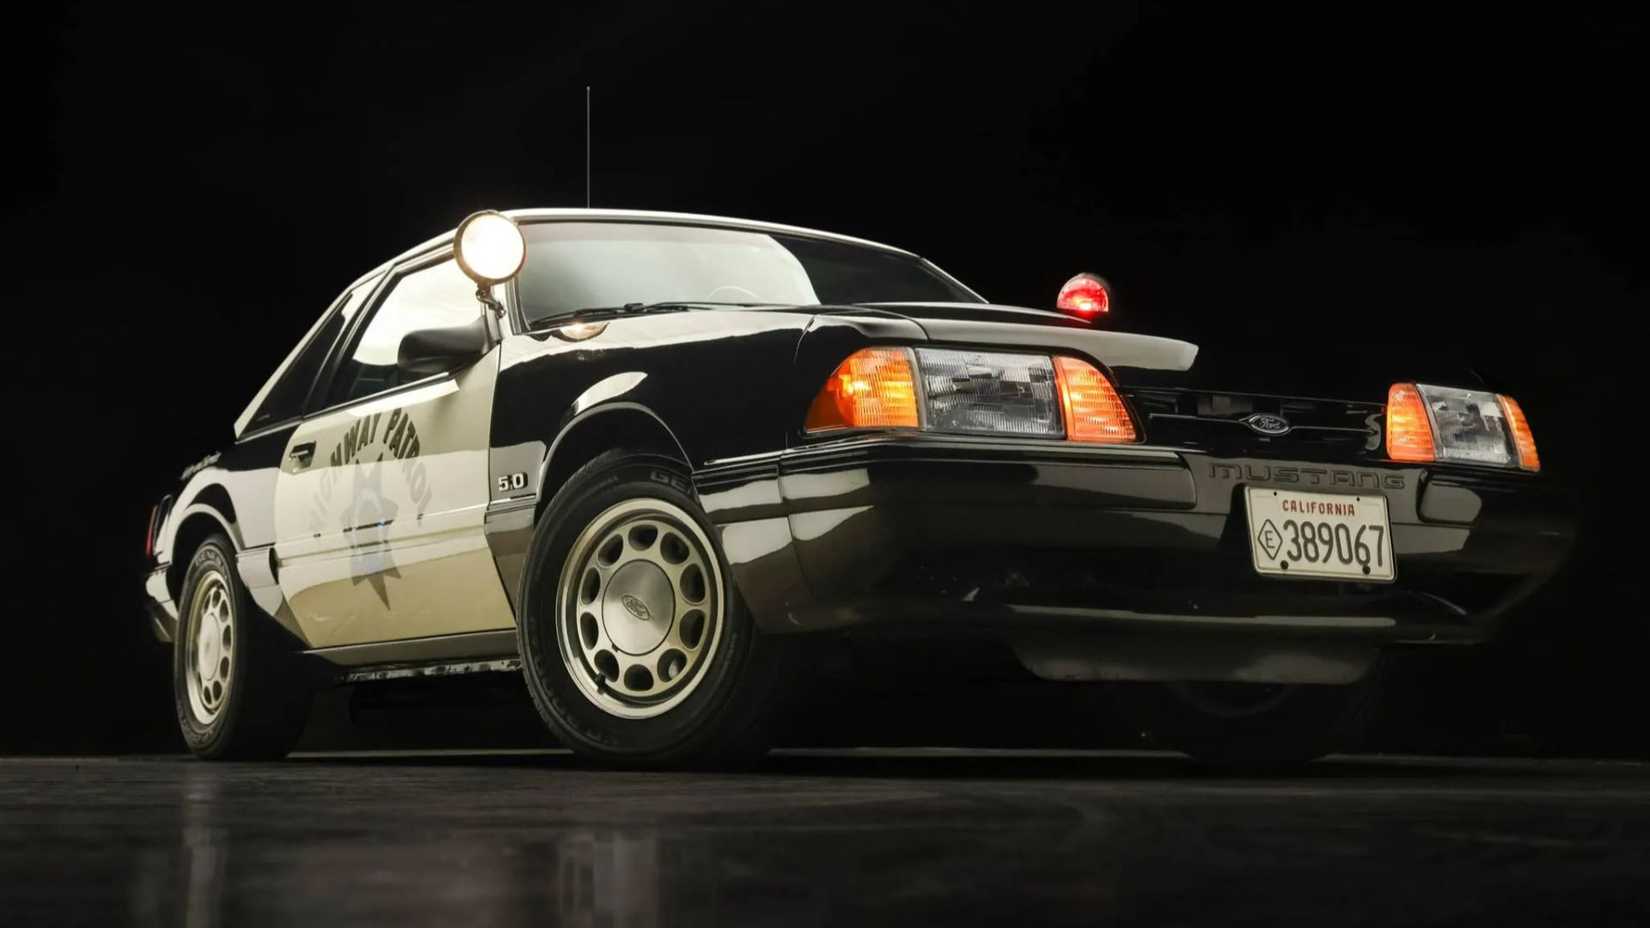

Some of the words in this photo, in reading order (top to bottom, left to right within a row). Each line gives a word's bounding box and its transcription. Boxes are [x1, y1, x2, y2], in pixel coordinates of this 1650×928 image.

[498, 473, 526, 491] 5.0
[1208, 462, 1406, 490] MUSTANG
[1282, 499, 1355, 517] CALIFORNIA
[1283, 519, 1384, 567] 389067
